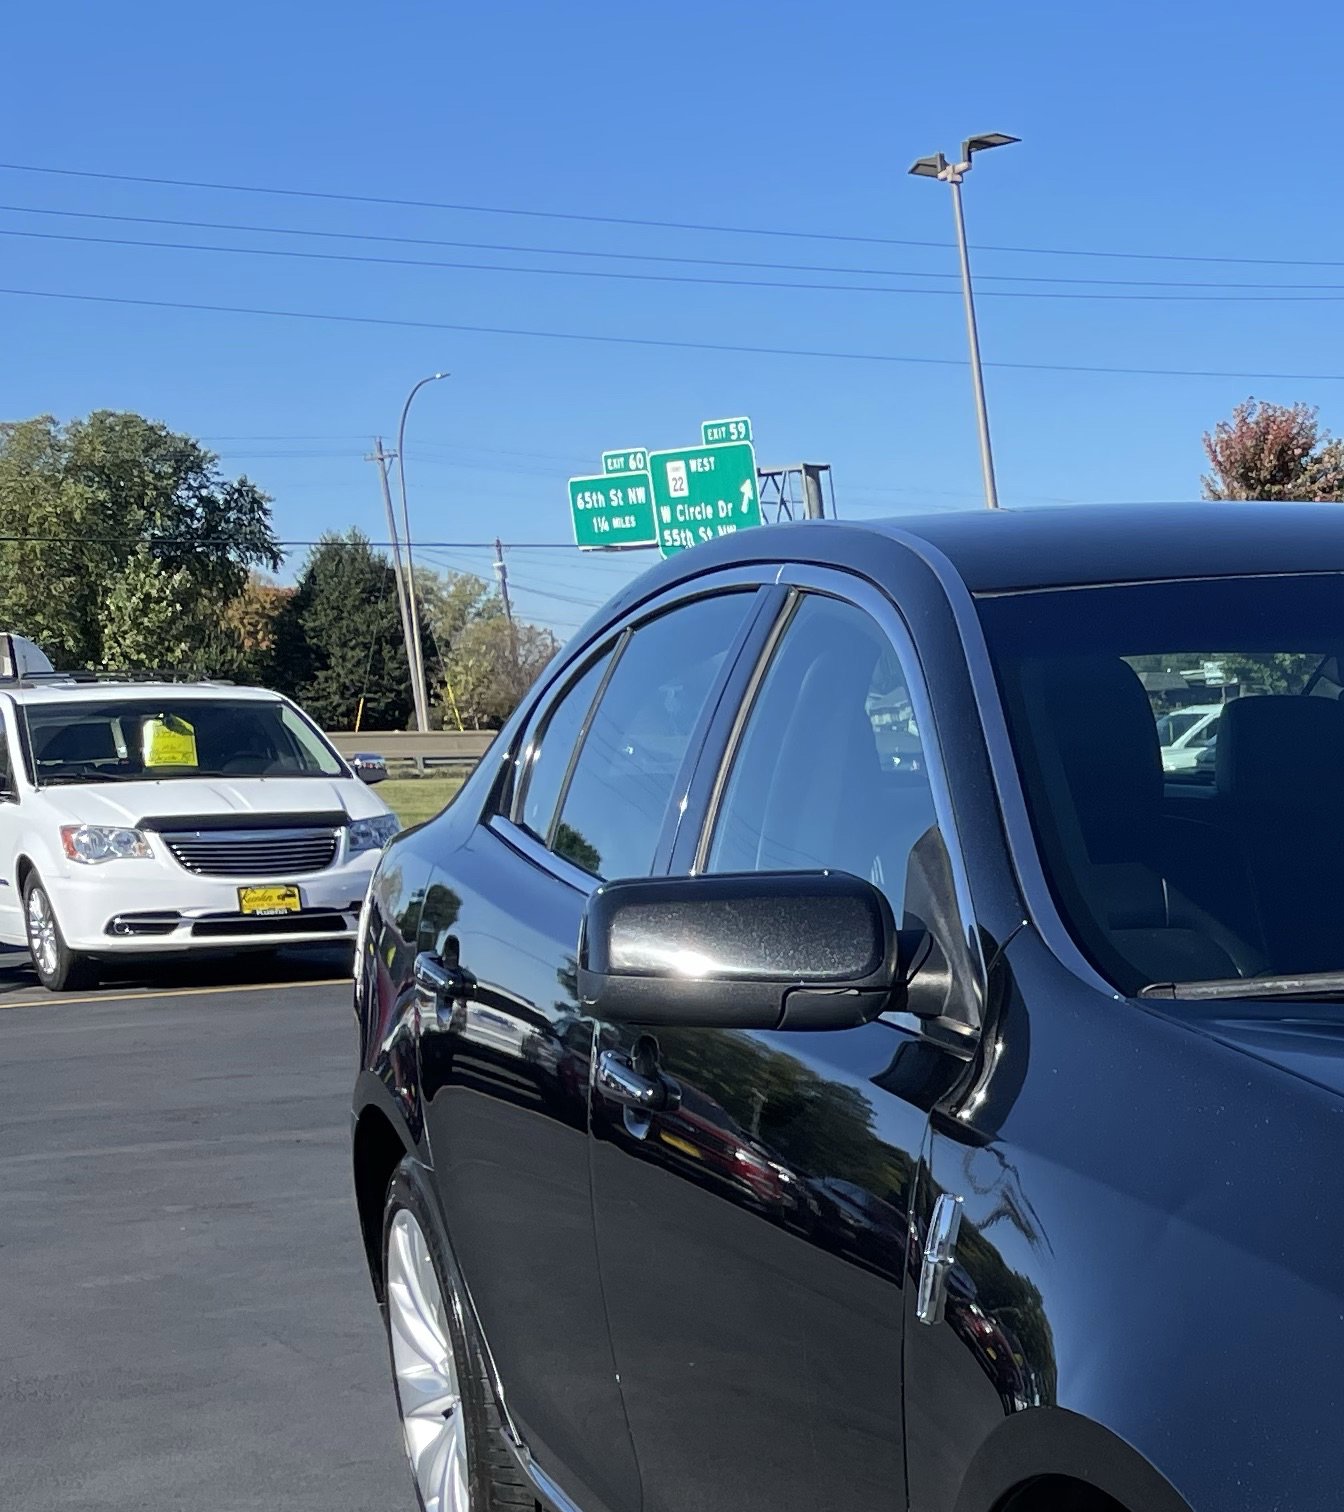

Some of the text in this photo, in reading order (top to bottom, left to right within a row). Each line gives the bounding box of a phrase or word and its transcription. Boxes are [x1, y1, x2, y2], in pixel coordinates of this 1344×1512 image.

[707, 422, 746, 441] EXIT 59
[607, 452, 644, 470] EXIT 60
[689, 456, 715, 472] WEST
[671, 476, 685, 492] 22
[576, 486, 646, 510] 65th St NW
[660, 499, 733, 524] W Circle Dr
[612, 514, 637, 529] MILES
[663, 527, 696, 549] 55th
[698, 525, 714, 541] St
